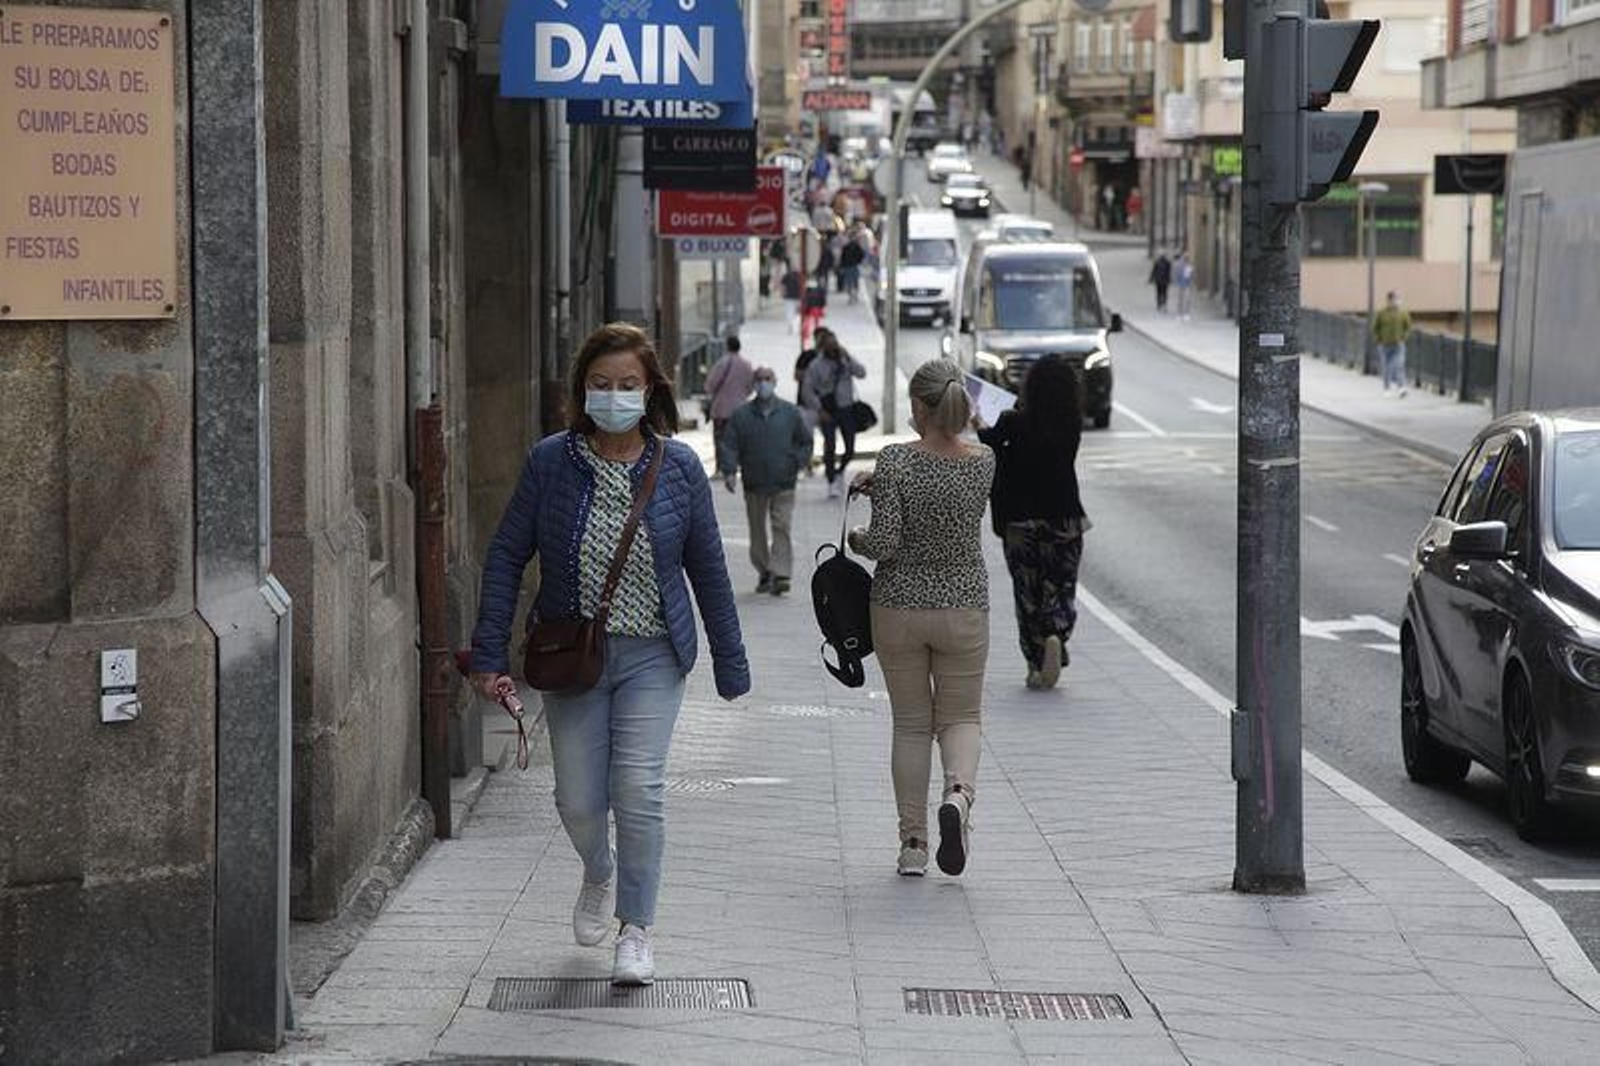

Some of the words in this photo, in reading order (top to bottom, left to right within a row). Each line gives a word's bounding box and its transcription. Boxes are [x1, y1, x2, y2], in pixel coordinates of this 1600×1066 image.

[0, 22, 23, 44] LE
[32, 23, 160, 50] PREPARAMOS
[535, 22, 715, 86] DAIN
[14, 66, 40, 89] SU
[49, 68, 111, 91] BOLSA
[119, 70, 149, 93] DE:
[600, 99, 721, 119] TEXTILES
[17, 108, 149, 135] CUMPLEAÑOS
[52, 153, 117, 176] BODAS
[28, 195, 121, 218] BAUTIZOS
[128, 196, 141, 216] Y
[670, 212, 736, 227] DIGITAL
[6, 236, 80, 259] FIESTAS
[680, 239, 694, 252] O
[63, 279, 164, 301] INFANTILES
